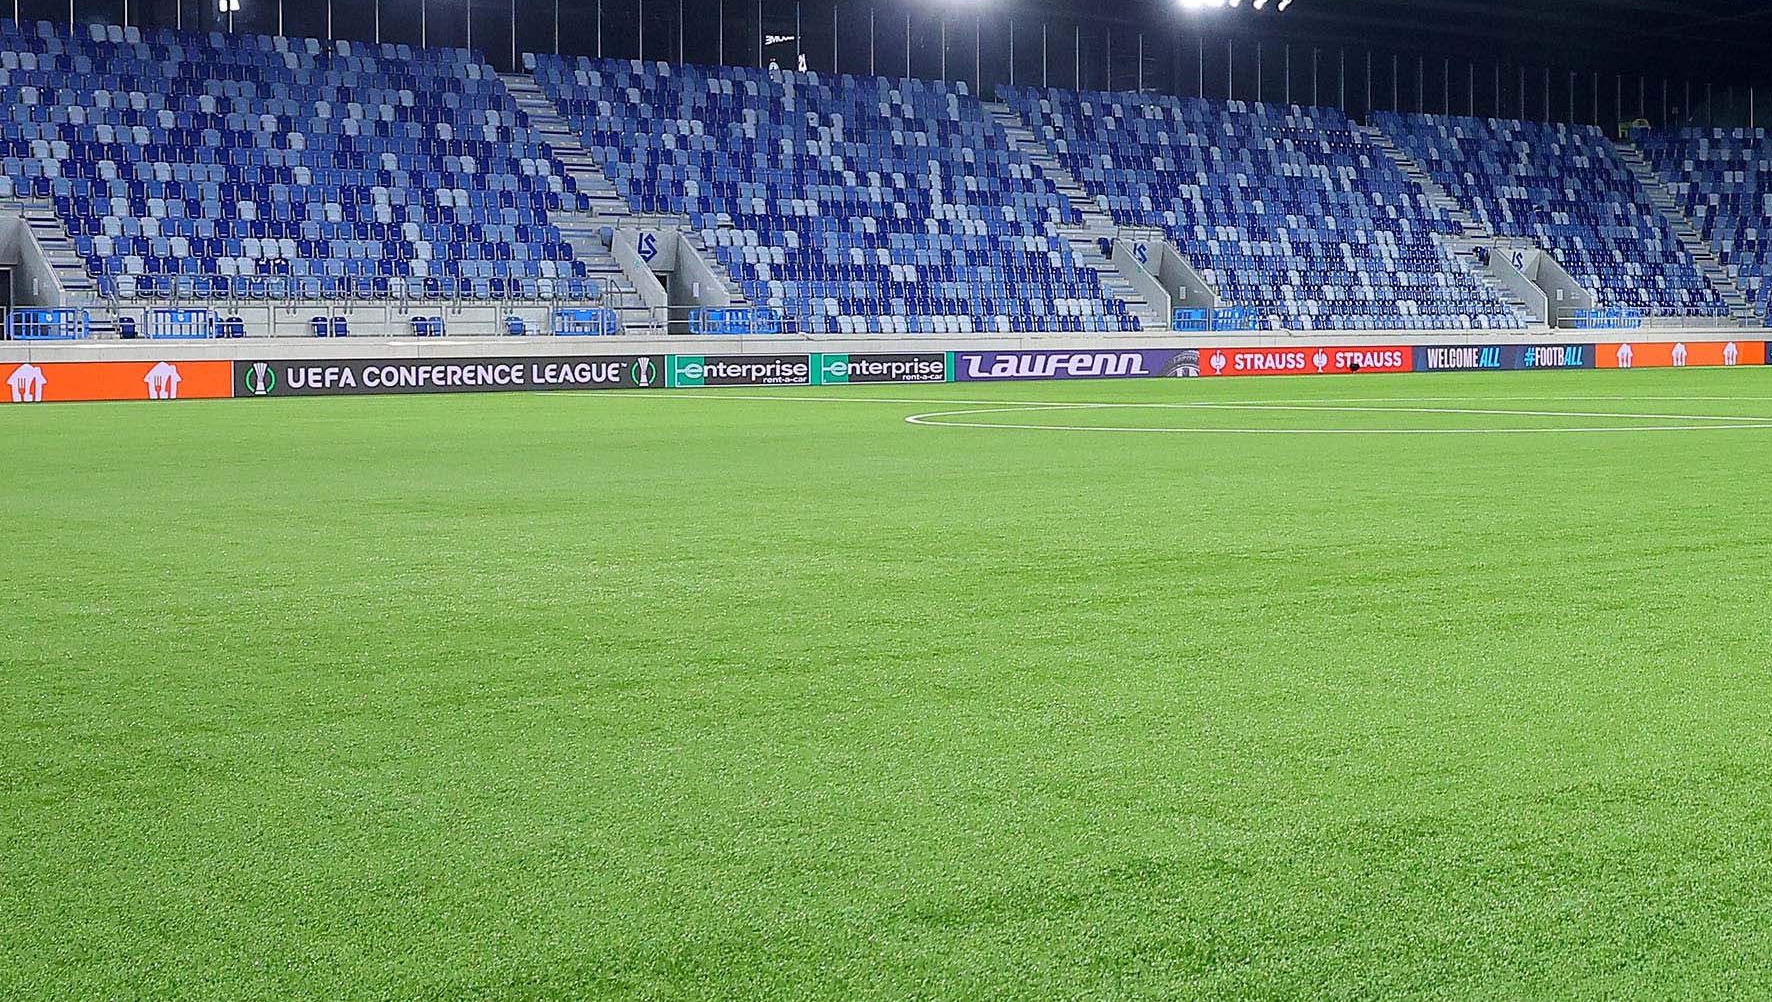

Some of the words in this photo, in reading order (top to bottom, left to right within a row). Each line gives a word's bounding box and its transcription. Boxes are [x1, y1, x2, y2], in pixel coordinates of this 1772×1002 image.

[1234, 353, 1305, 370] STRAUSS
[1335, 351, 1402, 368] STRAUSS
[1427, 348, 1479, 368] WELCOME
[1479, 348, 1500, 367] ALL
[1524, 347, 1583, 366] #FOOTBALL
[287, 366, 357, 388] UEFA
[362, 364, 524, 387] CONFERENCE
[684, 359, 808, 380] enterprise
[830, 358, 944, 378] enterprise
[902, 372, 943, 381] rent-a-car
